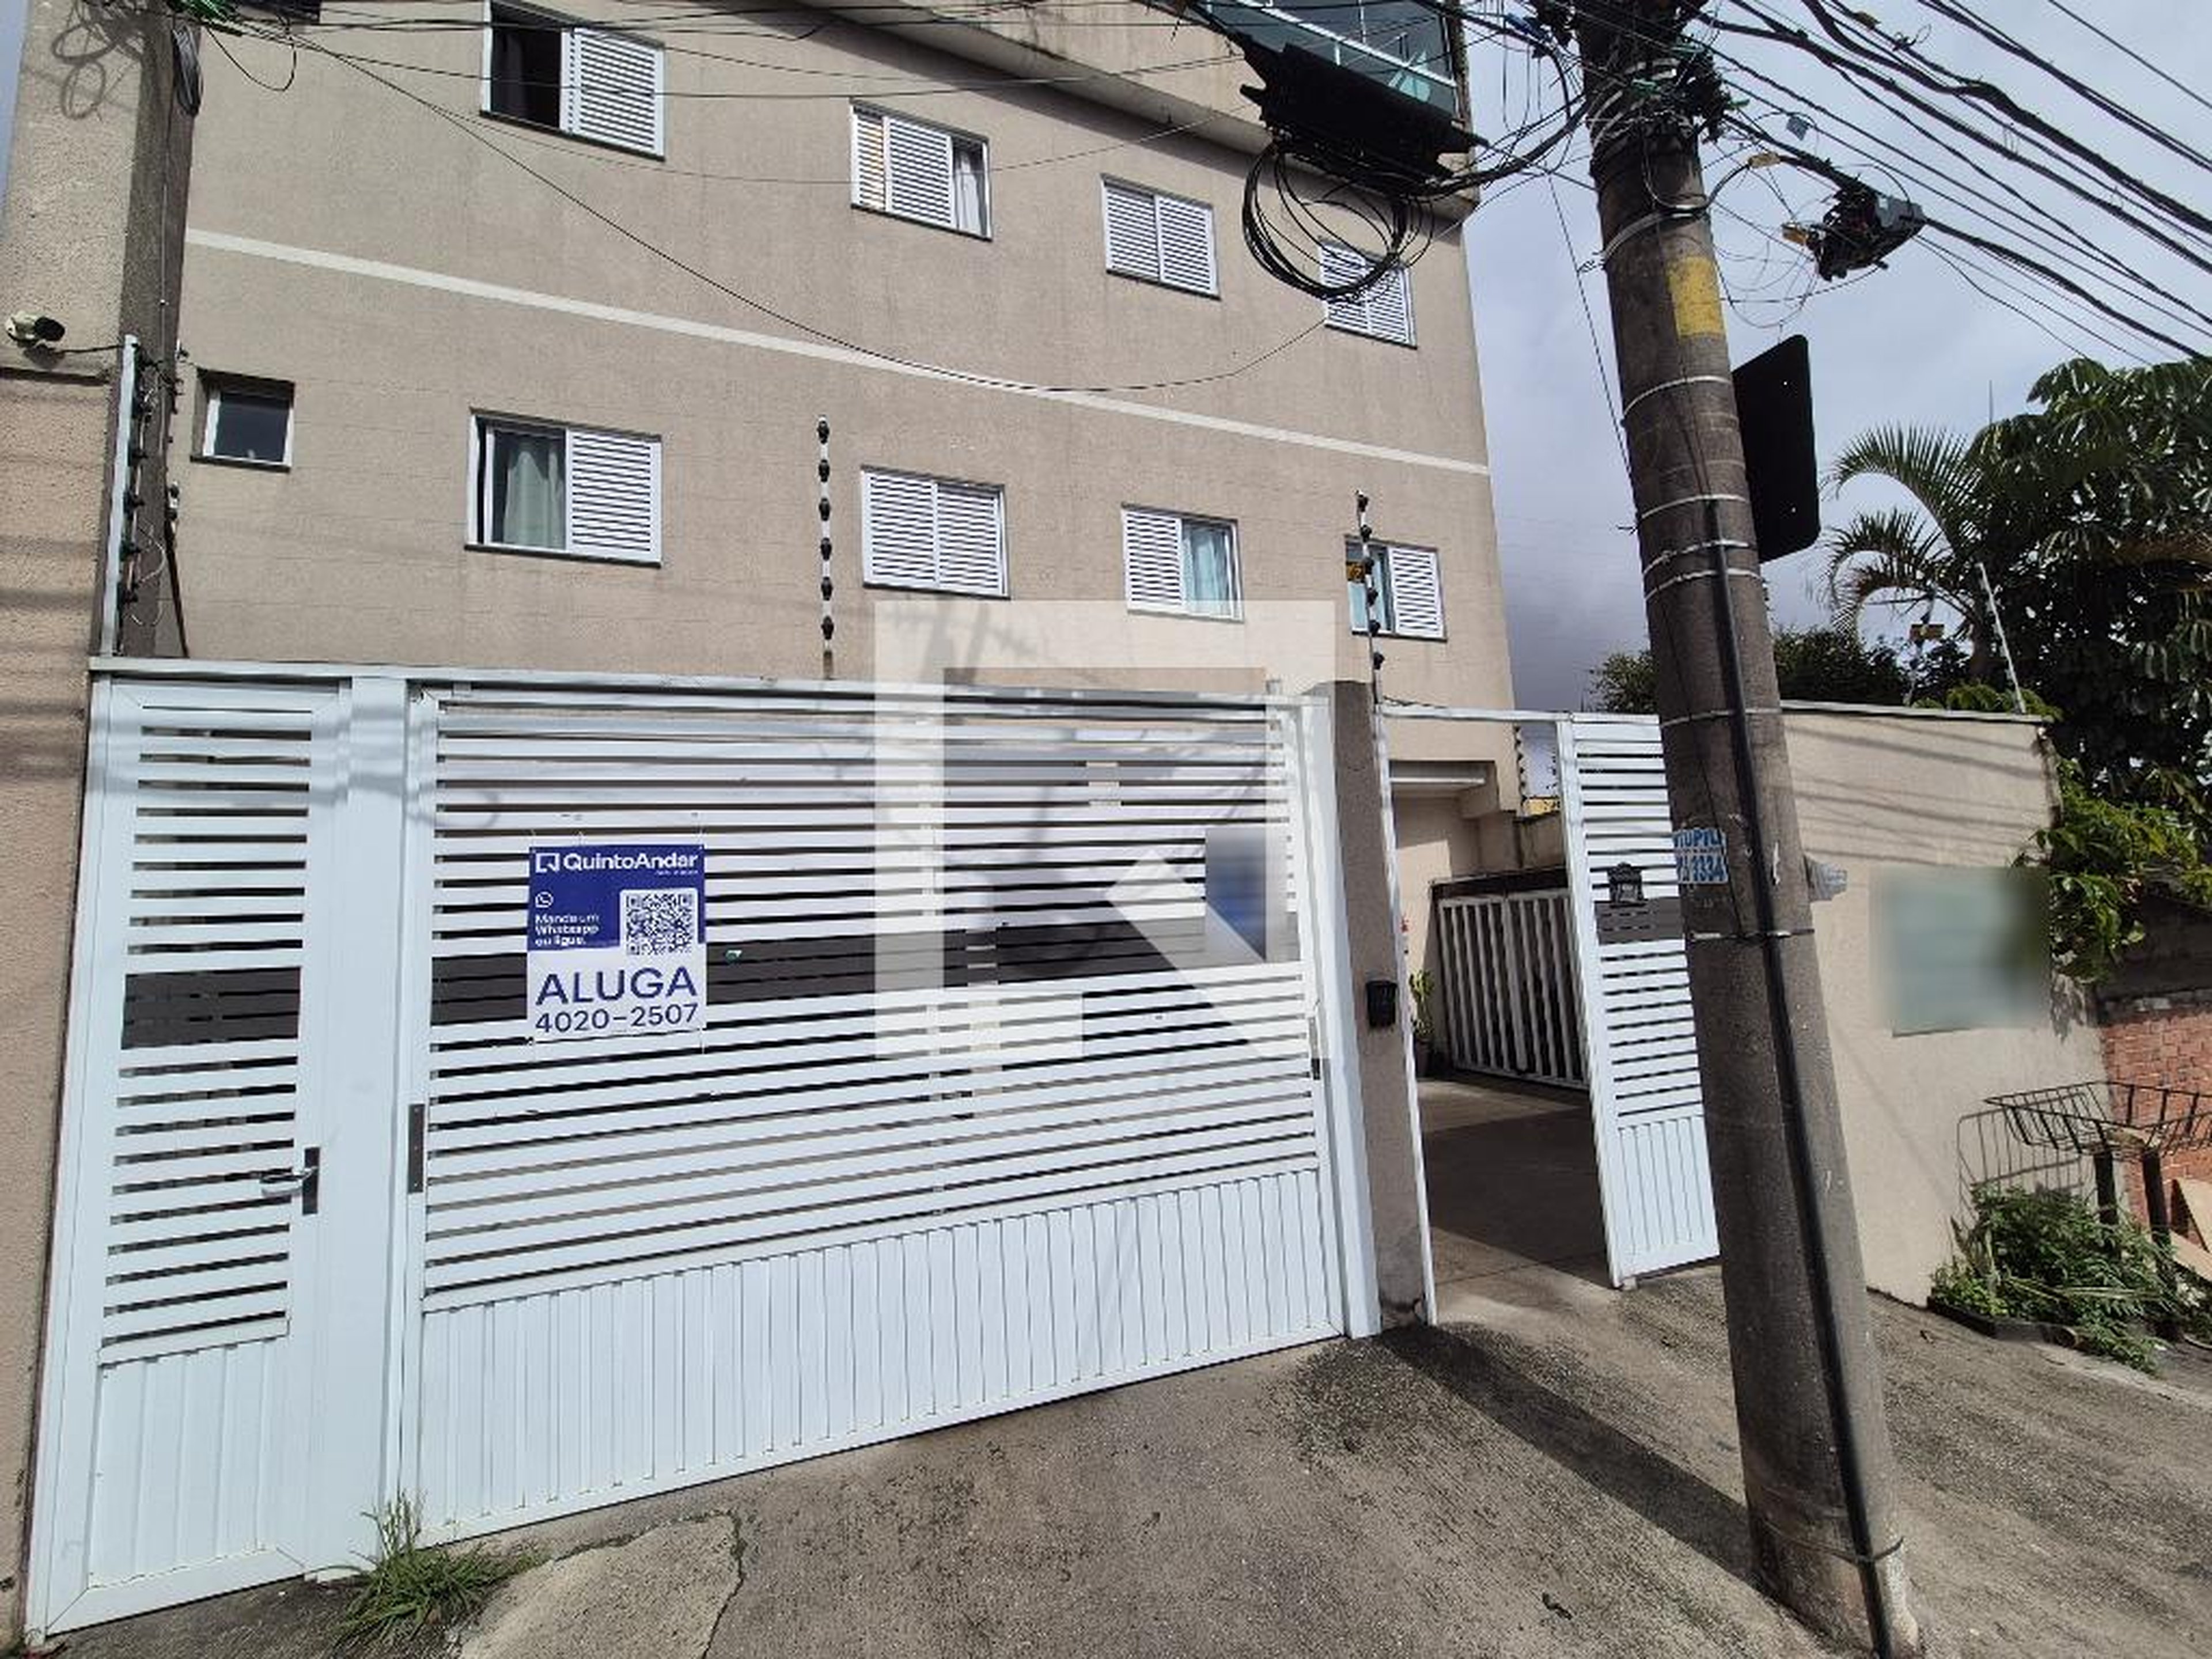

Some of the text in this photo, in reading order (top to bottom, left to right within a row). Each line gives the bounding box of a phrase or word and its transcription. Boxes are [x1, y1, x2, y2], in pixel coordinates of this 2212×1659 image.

[563, 852, 699, 871] QuintoAndar
[536, 966, 698, 1006] ALUGA
[535, 1002, 698, 1033] 4020-2507
